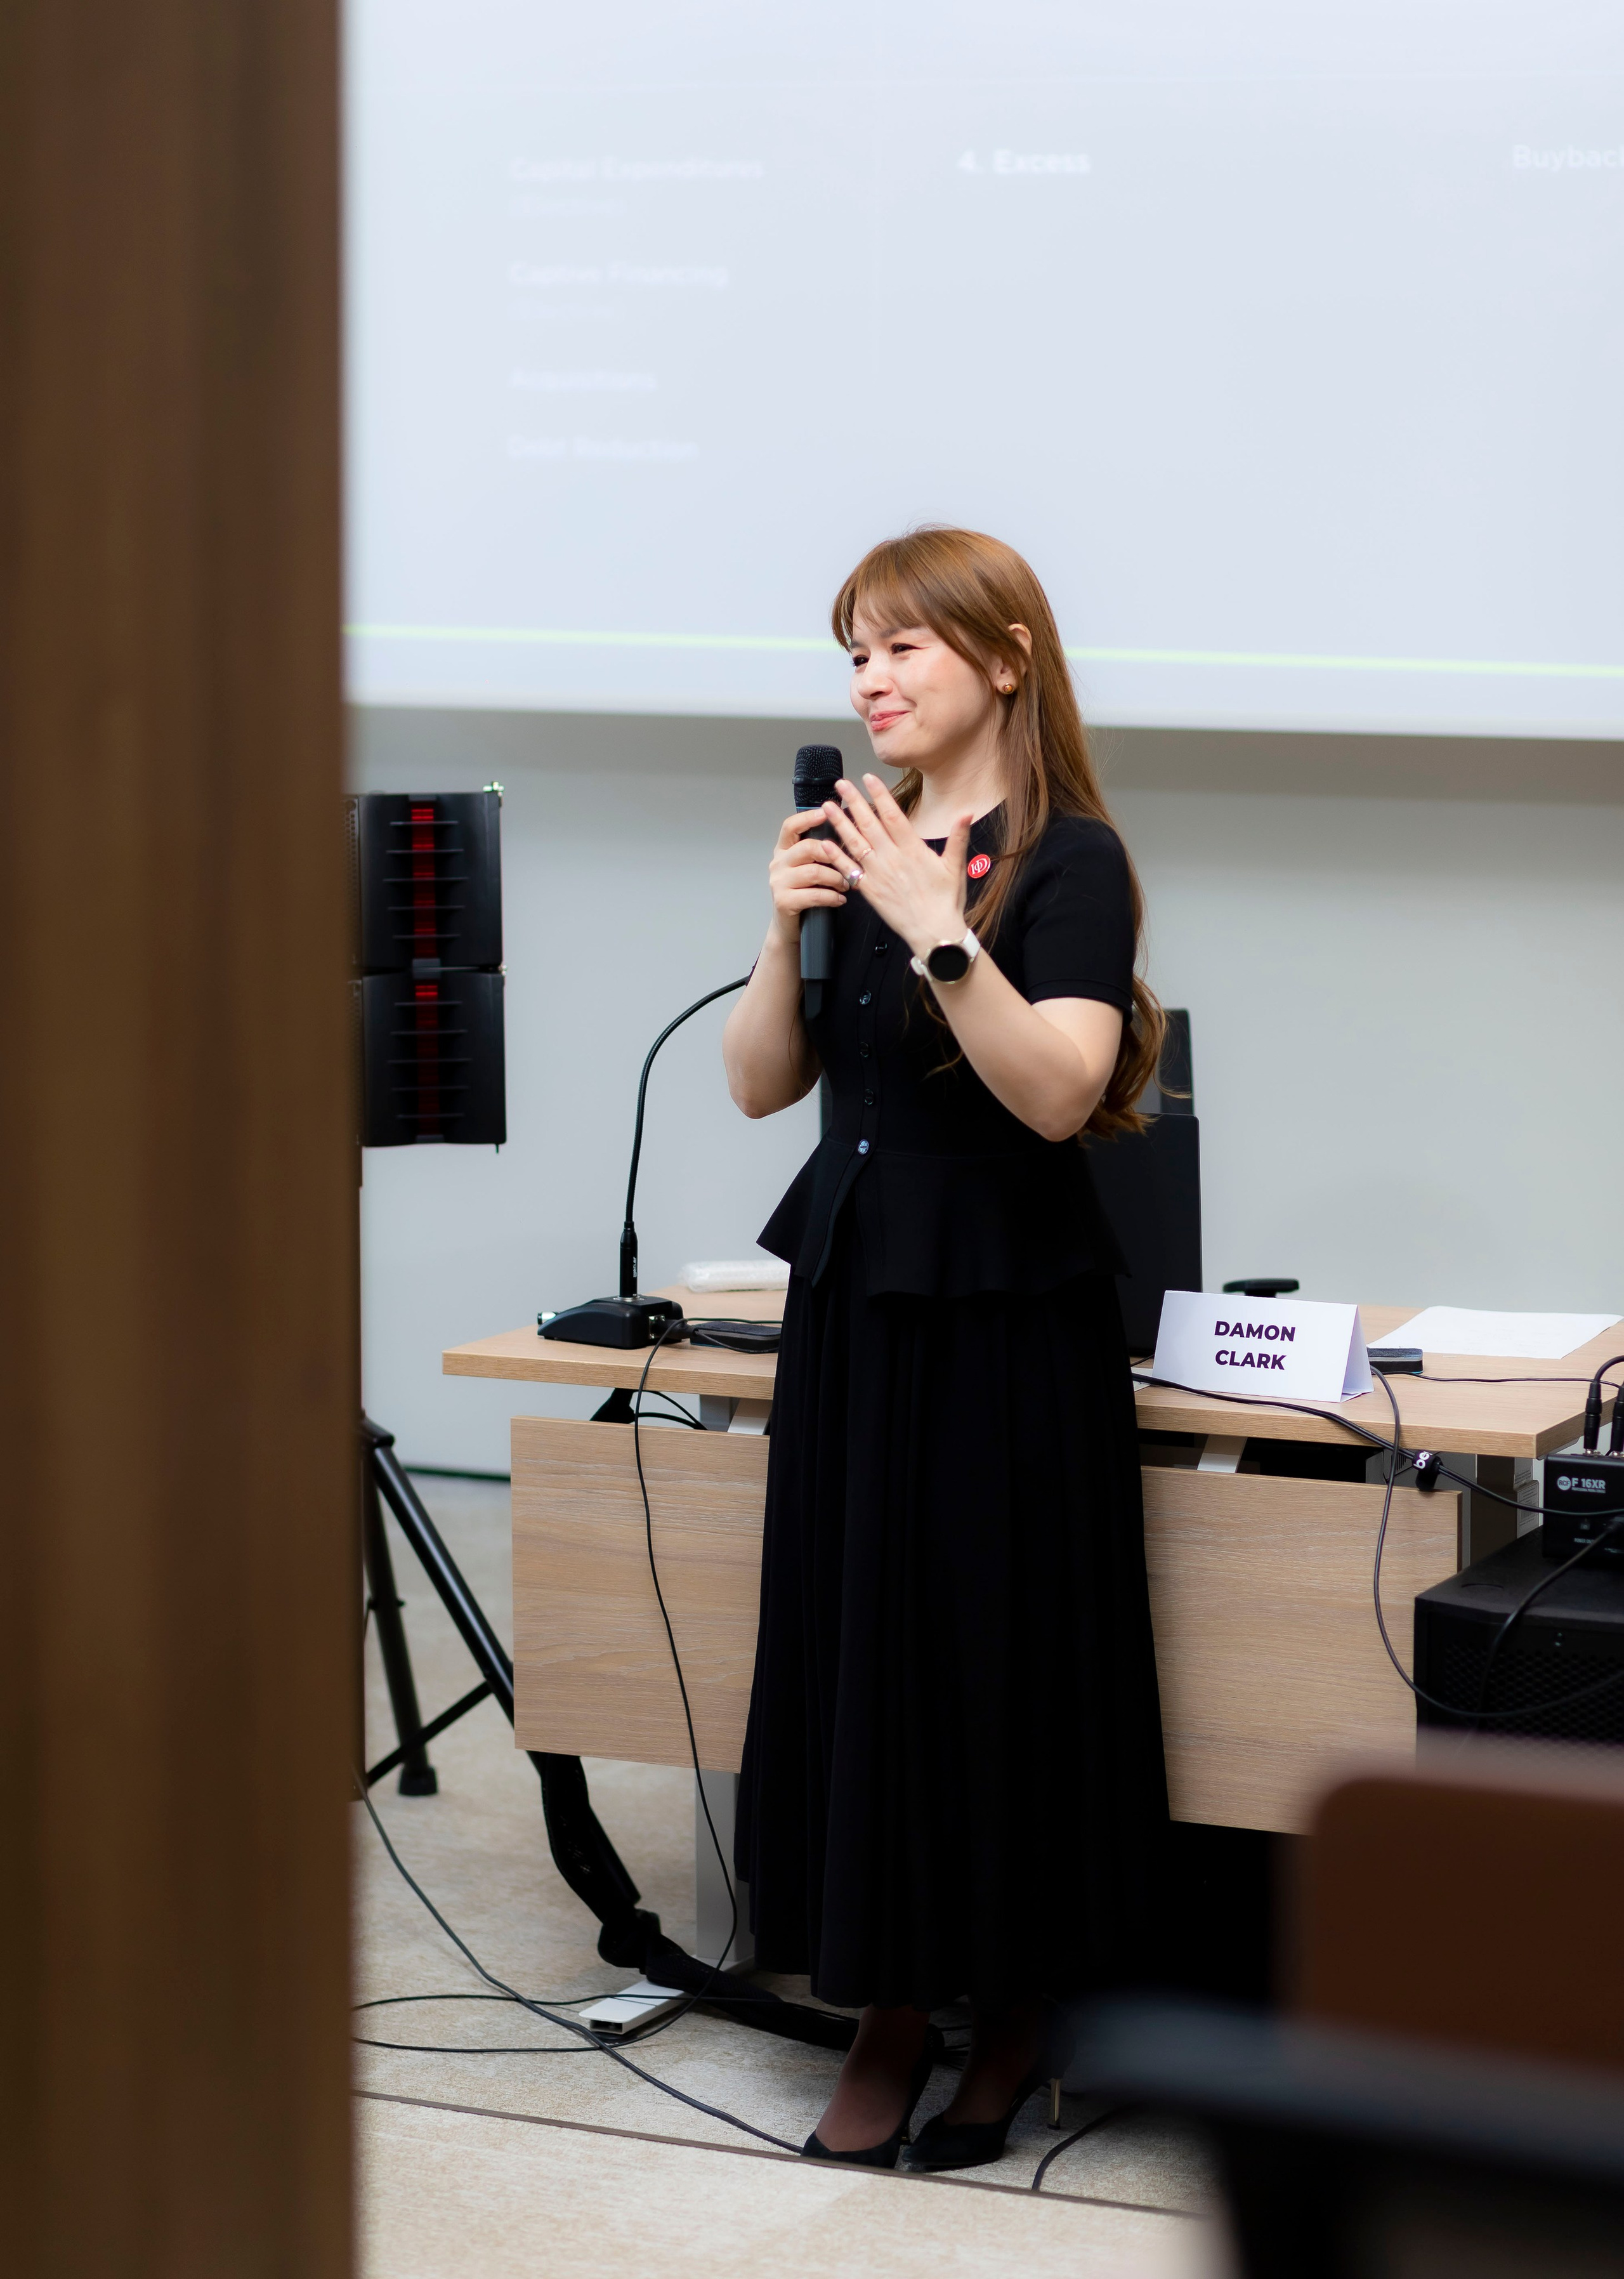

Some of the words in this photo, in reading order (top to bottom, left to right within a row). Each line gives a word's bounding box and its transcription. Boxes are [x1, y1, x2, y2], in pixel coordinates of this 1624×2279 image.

[602, 157, 764, 180] Expenditures
[957, 150, 984, 174] 4.
[994, 149, 1090, 174] Excess
[608, 261, 730, 288] Financing
[1214, 1321, 1295, 1342] DAMON
[1215, 1350, 1287, 1370] CLARK
[1572, 1478, 1578, 1487] F
[1581, 1478, 1606, 1489] 16XR
